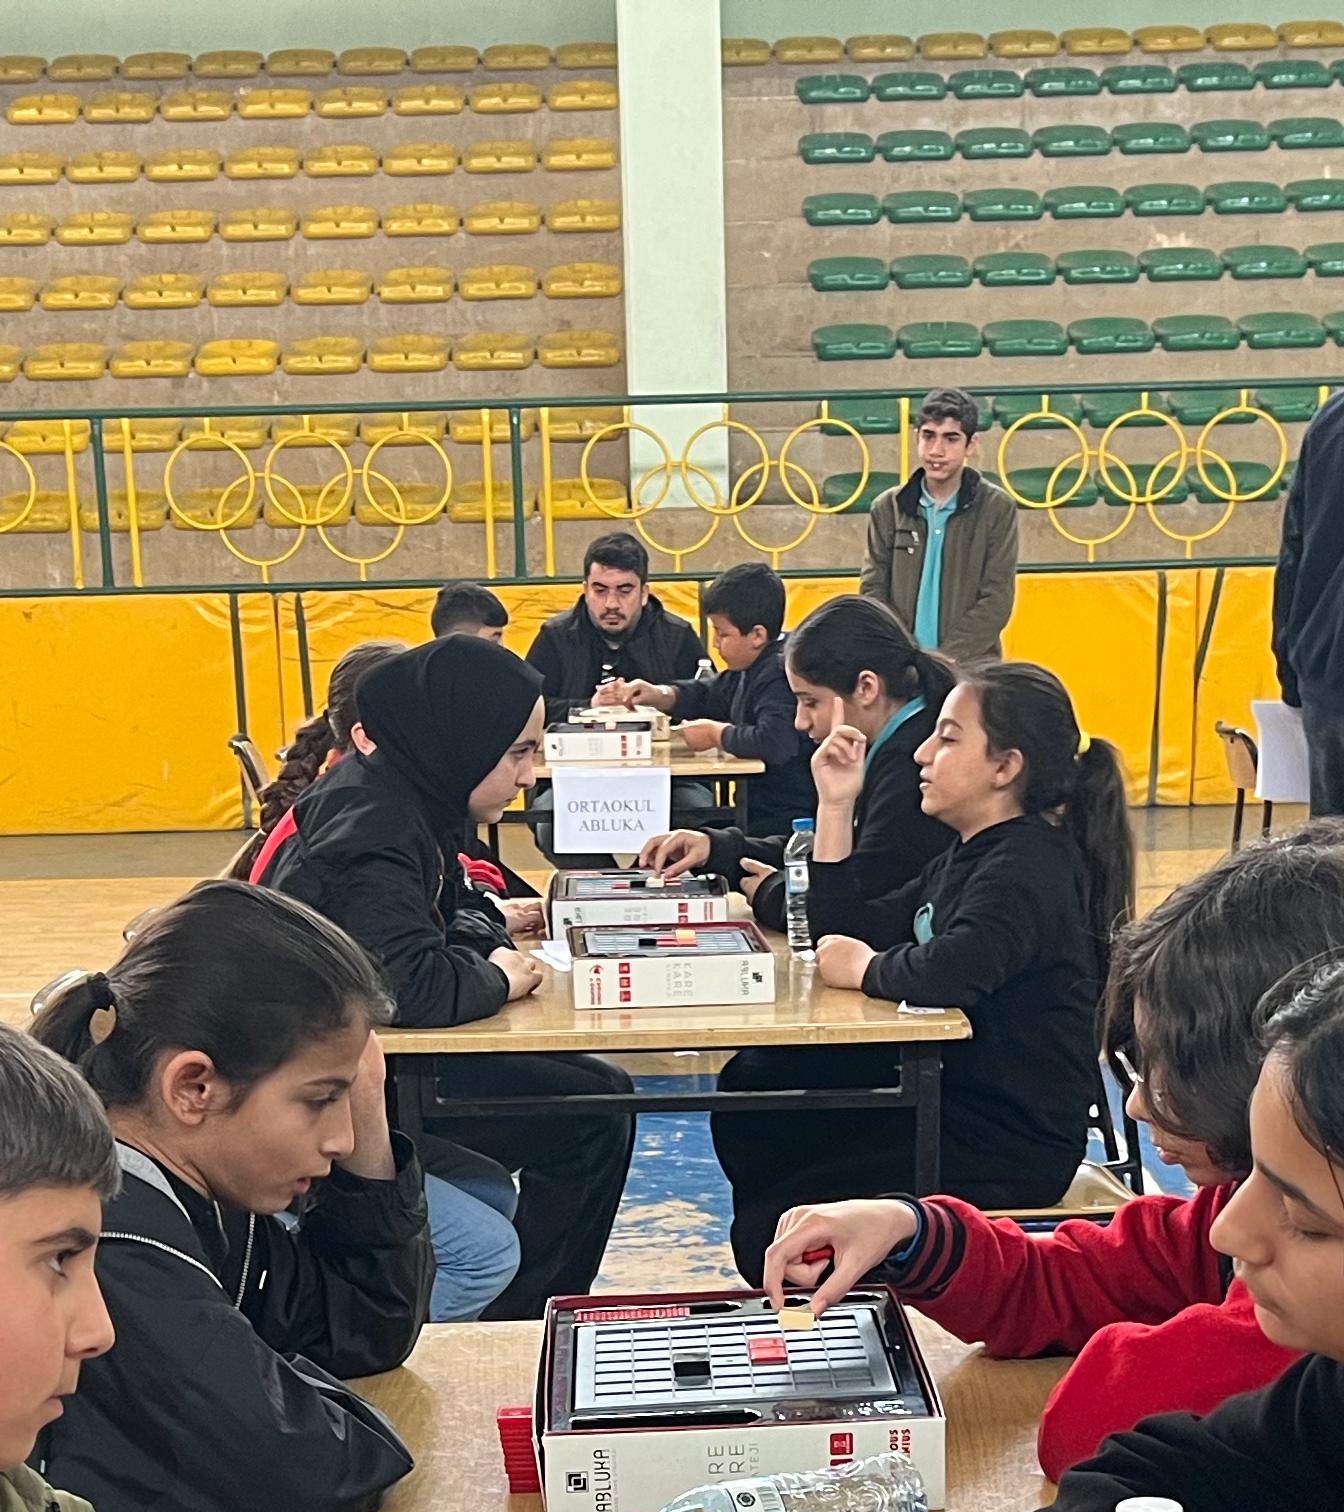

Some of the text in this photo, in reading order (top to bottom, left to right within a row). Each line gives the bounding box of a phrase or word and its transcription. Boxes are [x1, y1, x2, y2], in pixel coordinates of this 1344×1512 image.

[567, 799, 656, 814] ORTAOKUL
[578, 819, 645, 832] ABLUKA
[901, 1428, 911, 1457] NIUS
[708, 1444, 724, 1475] RE
[729, 1443, 745, 1474] RE
[593, 1449, 613, 1512] ABLUKA
